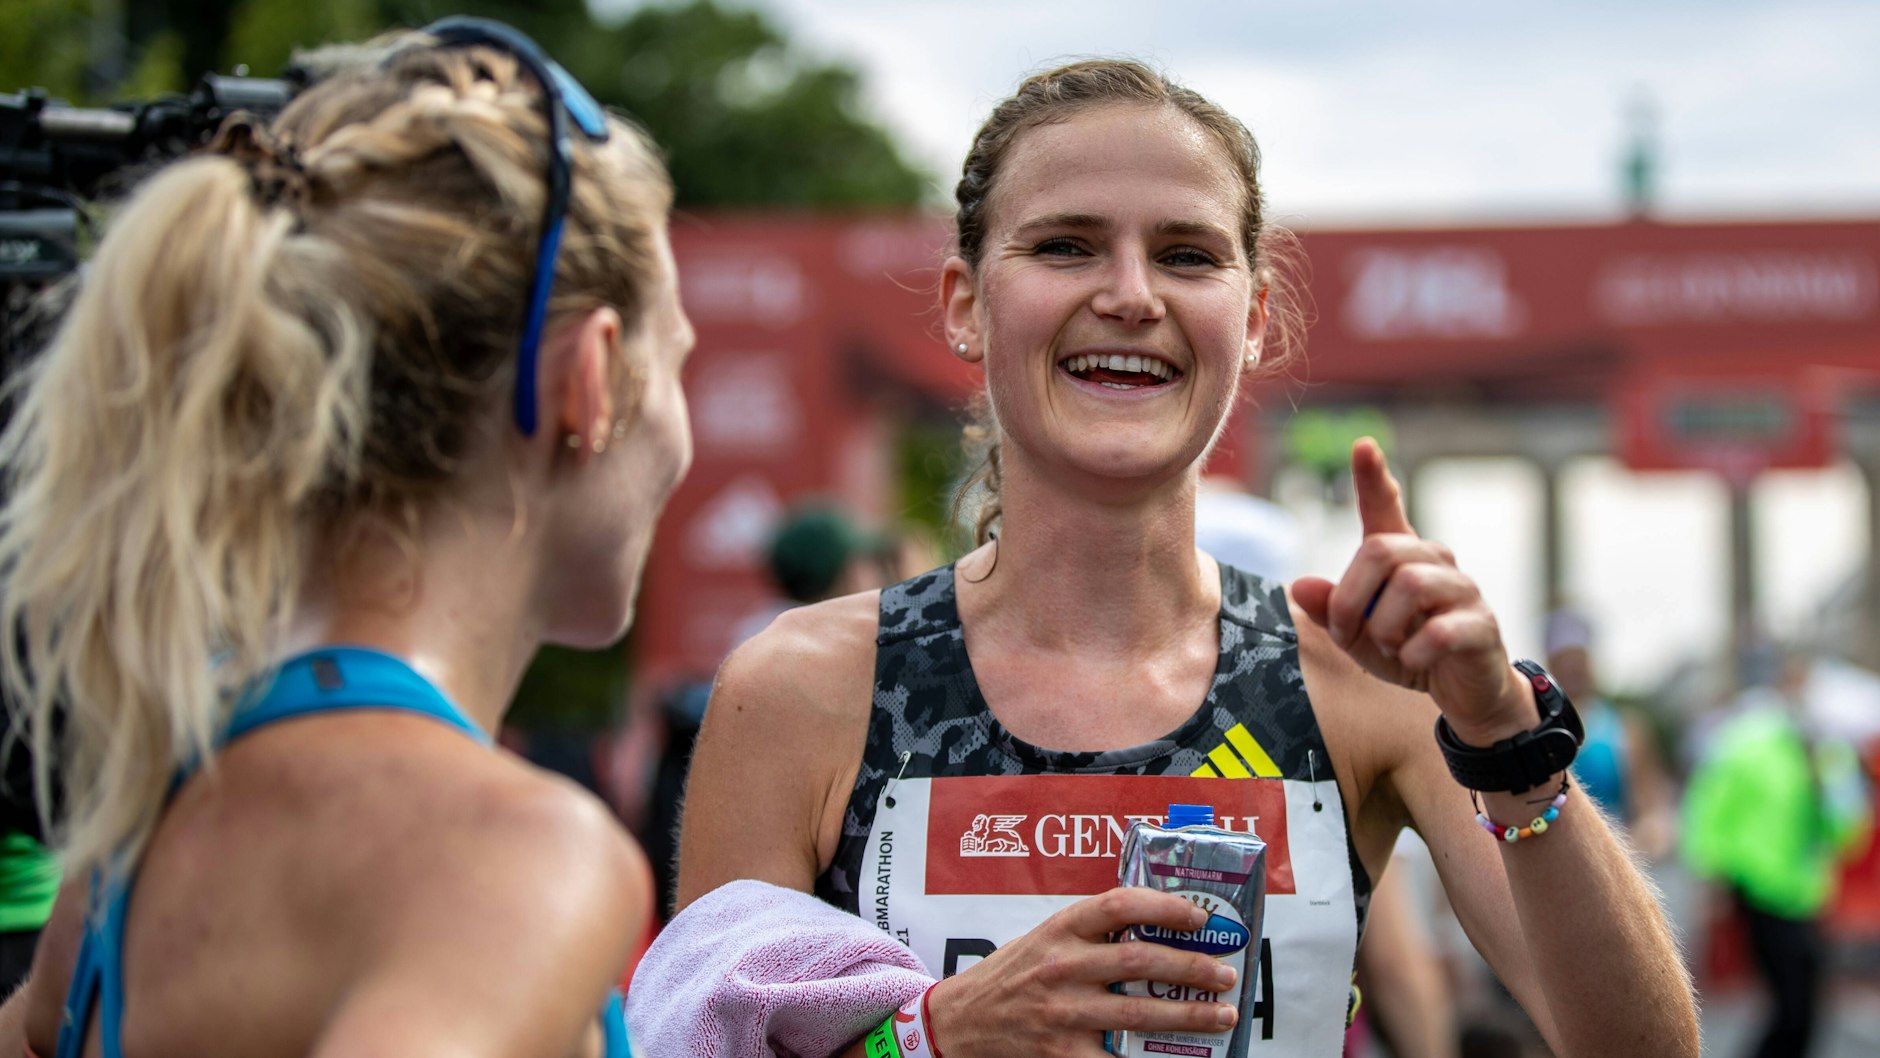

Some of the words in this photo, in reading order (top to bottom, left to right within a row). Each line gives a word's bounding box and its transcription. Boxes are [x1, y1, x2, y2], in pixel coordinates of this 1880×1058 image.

[1174, 866, 1223, 881] NATRIUMARM
[876, 831, 893, 935] BMARATHON
[1175, 1035, 1224, 1047] MINERALWASSER
[1147, 1042, 1165, 1052] OHNE
[1165, 1044, 1209, 1057] KOHLENSÄURE
